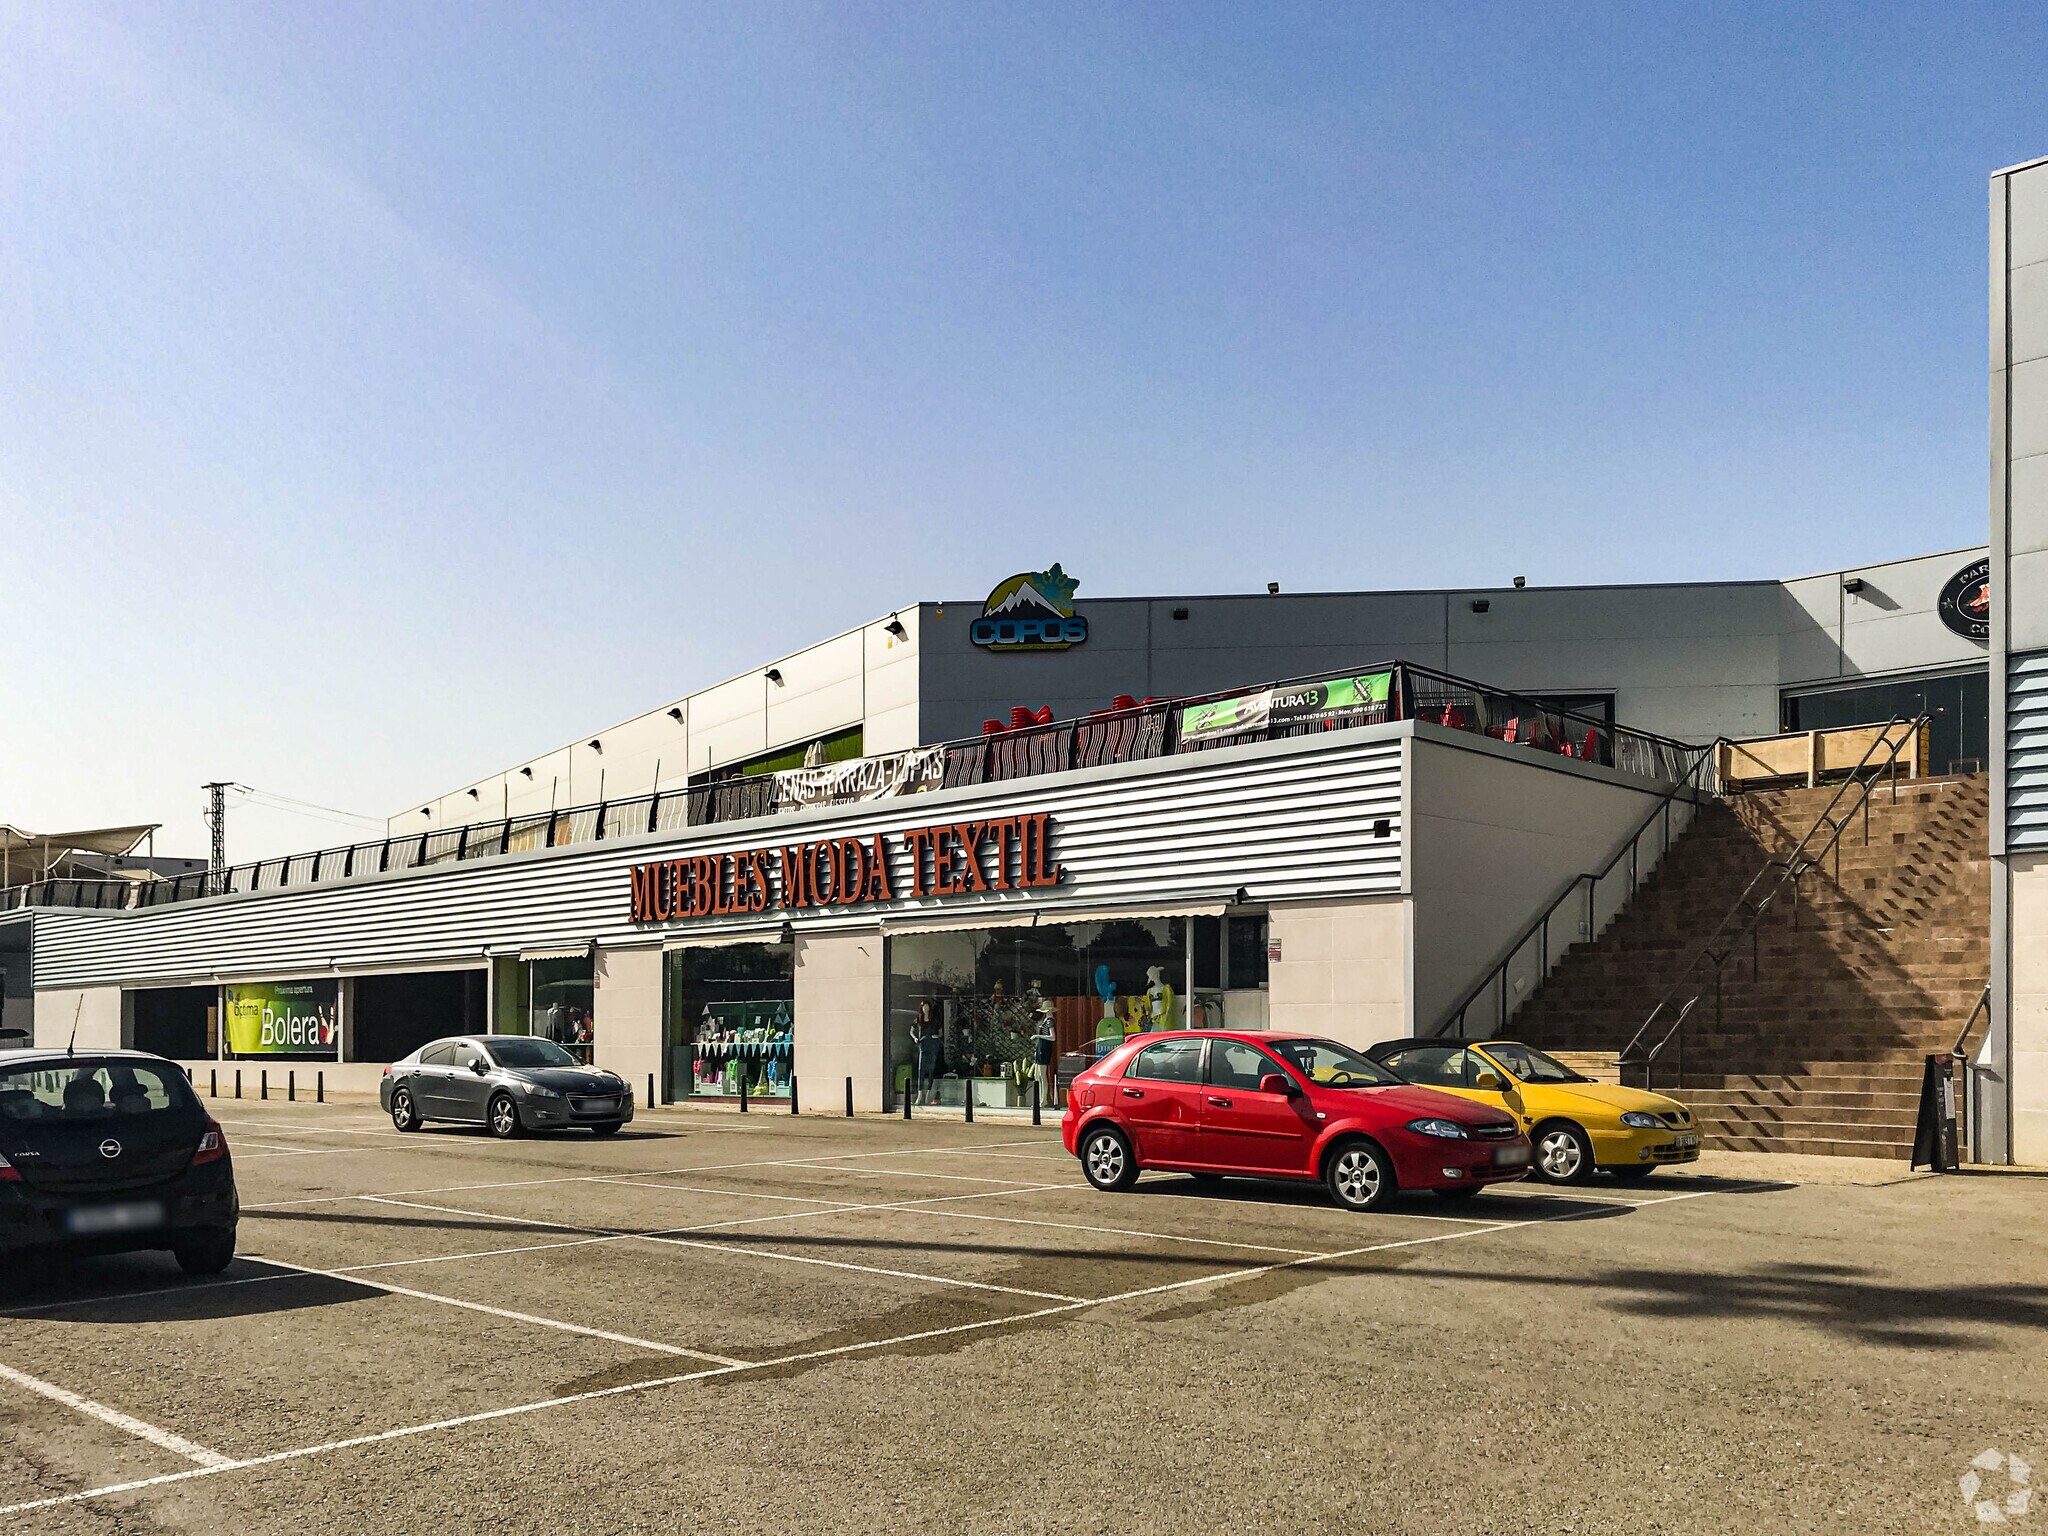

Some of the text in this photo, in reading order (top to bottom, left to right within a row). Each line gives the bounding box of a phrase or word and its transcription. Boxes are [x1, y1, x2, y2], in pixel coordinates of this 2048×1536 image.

[971, 617, 1087, 645] COPOS
[628, 813, 1062, 923] MUEBLES MODA TEXTIL
[261, 1007, 319, 1046] Bolera
